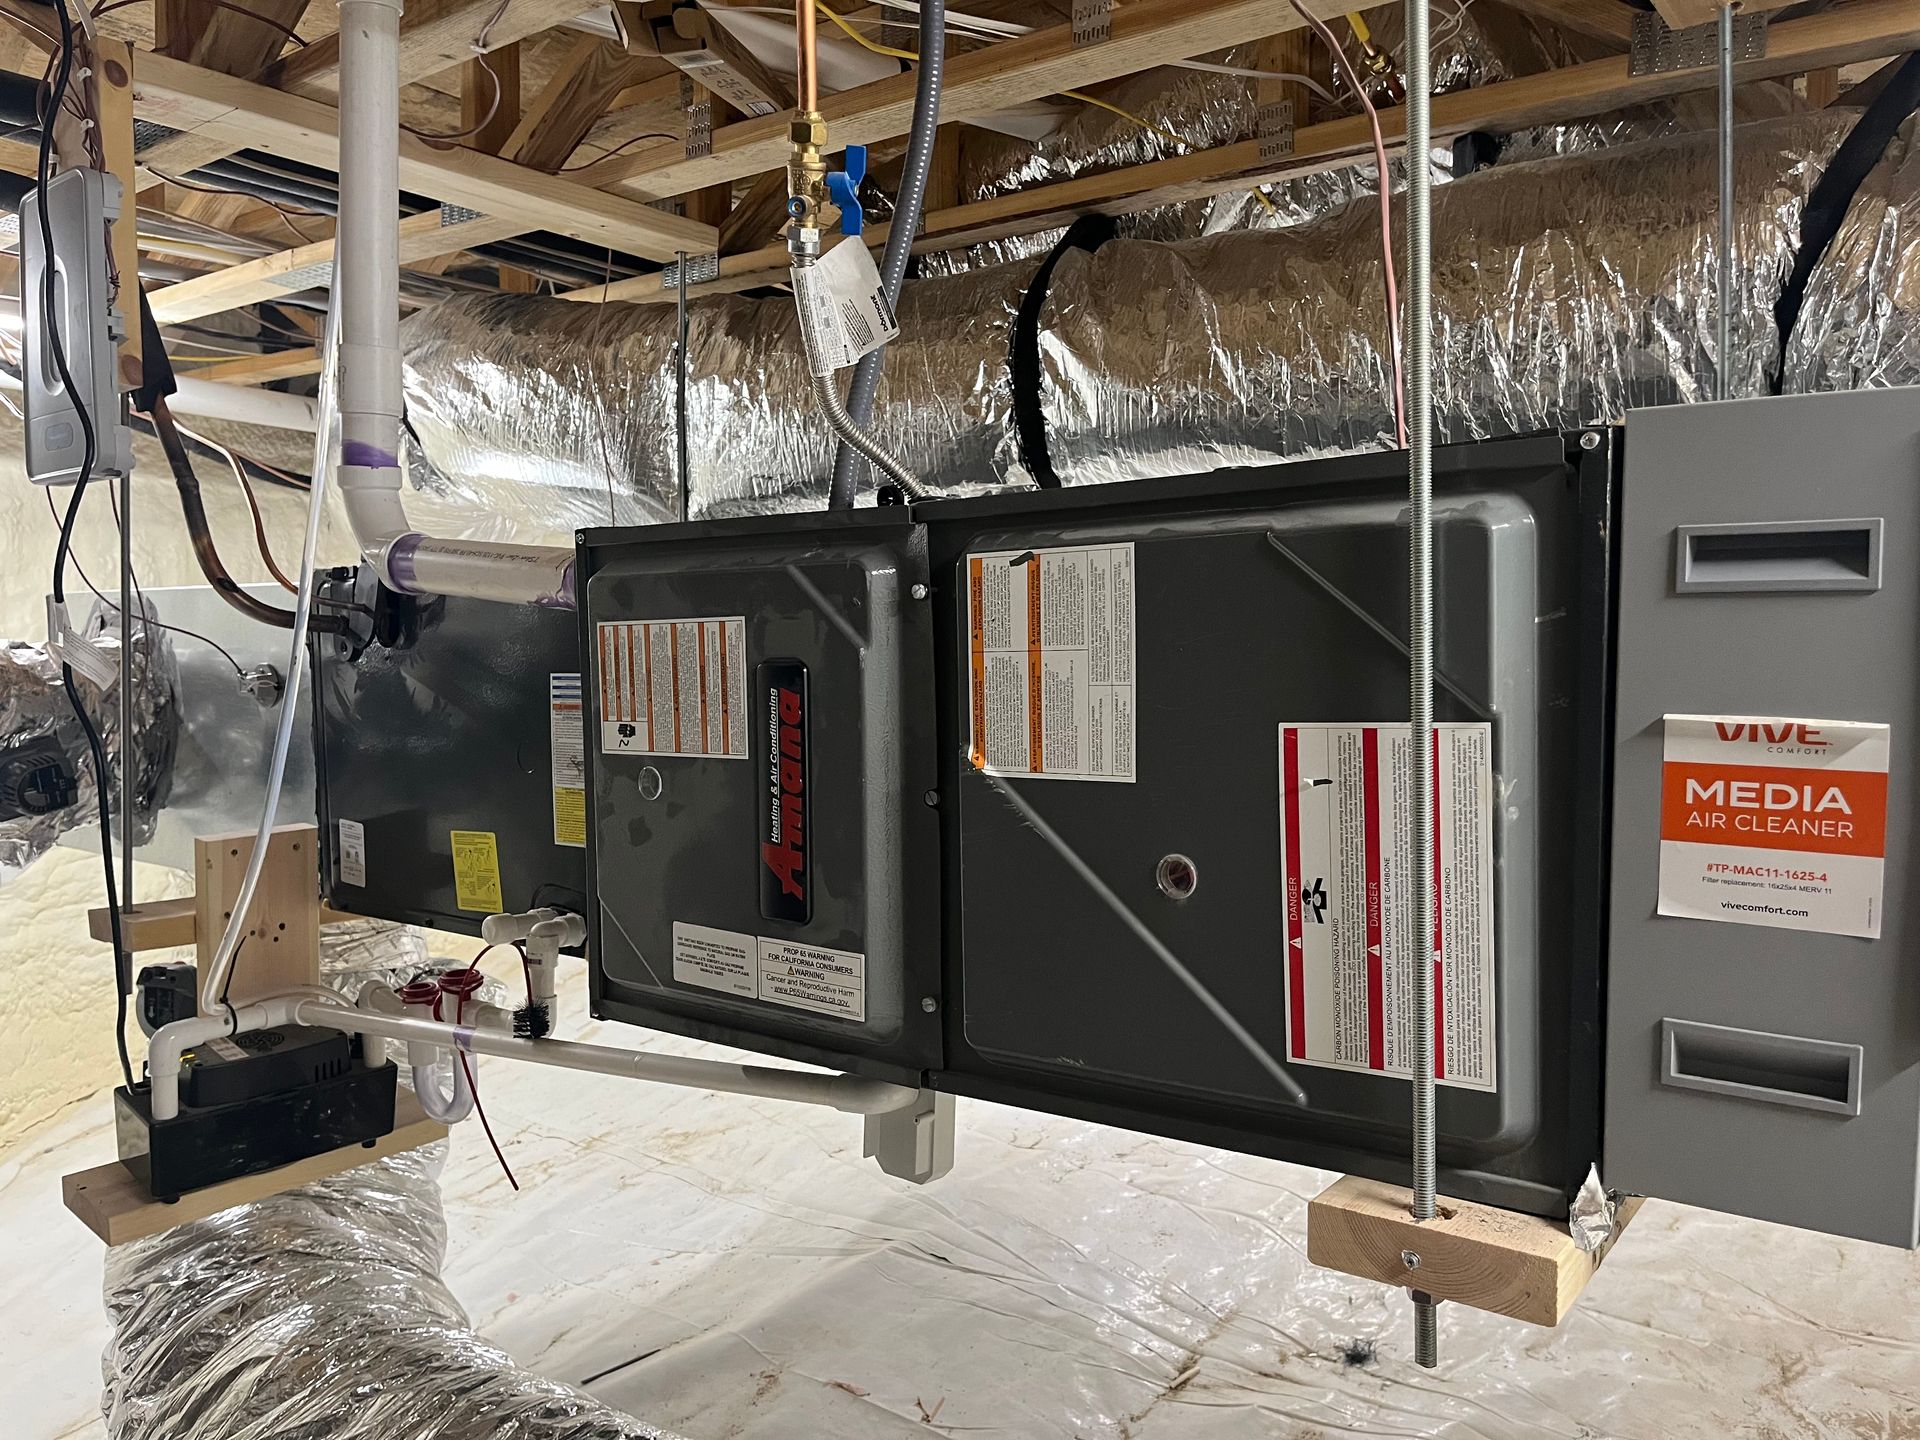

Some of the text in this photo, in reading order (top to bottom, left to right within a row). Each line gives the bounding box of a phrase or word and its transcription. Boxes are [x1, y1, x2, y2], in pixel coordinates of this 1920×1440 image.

[768, 687, 779, 763] Conditioning
[1767, 746, 1827, 755] COMFORT
[769, 765, 777, 782] Air
[762, 688, 805, 900] Amana
[1685, 777, 1853, 815] MEDIA
[770, 798, 781, 843] Heating
[1685, 809, 1853, 839] AIR CLEANER
[1706, 862, 1827, 883] #TP-MAC11-1625-4
[1701, 876, 1719, 884] Filter
[1798, 885, 1821, 893] MERV
[1289, 877, 1298, 921] DANGER
[1369, 882, 1378, 927] DANGER
[1384, 894, 1390, 904] DE
[1720, 899, 1809, 918] vivecomfort.com
[1444, 906, 1451, 916] DE
[768, 952, 853, 974] FOR CALIFORNIA CONSUMERS
[783, 946, 798, 956] PROP
[807, 951, 834, 962] WARNING
[1385, 949, 1391, 959] AU
[766, 973, 854, 997] Cancer and Reproductive Harm
[794, 968, 824, 980] WARNING
[1385, 962, 1393, 1036] D'EMPOISONNEMENT
[1444, 978, 1453, 1032] INTOXICACIÓN
[1446, 1034, 1453, 1044] DE
[1446, 1045, 1454, 1075] RIESGO
